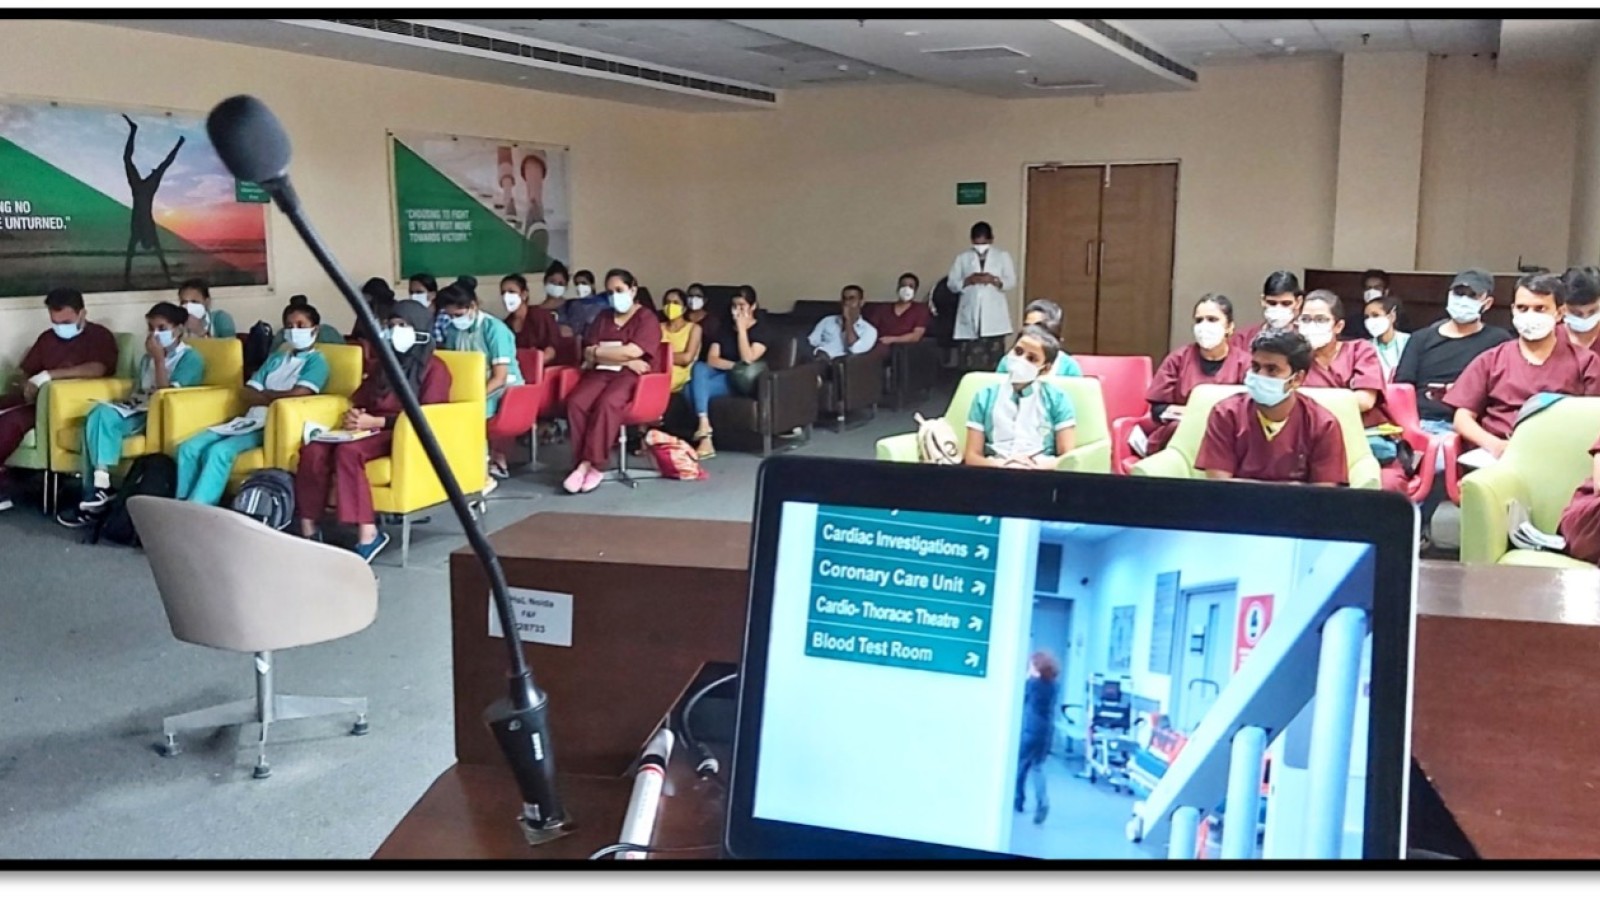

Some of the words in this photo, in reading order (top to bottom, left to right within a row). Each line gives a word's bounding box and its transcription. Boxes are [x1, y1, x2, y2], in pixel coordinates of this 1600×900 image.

[5, 215, 71, 230] UNTURNED."
[14, 200, 31, 214] NO
[822, 524, 874, 546] Cardiac
[876, 530, 969, 557] Investigations
[819, 560, 890, 587] Coronary
[893, 569, 929, 588] Care
[932, 574, 964, 593] Unit
[815, 596, 860, 616] Cardio-
[862, 601, 914, 624] Thoracic
[915, 608, 961, 630] Theatre
[812, 631, 855, 652] Blood
[858, 637, 889, 656] Test
[890, 641, 933, 662] Room
